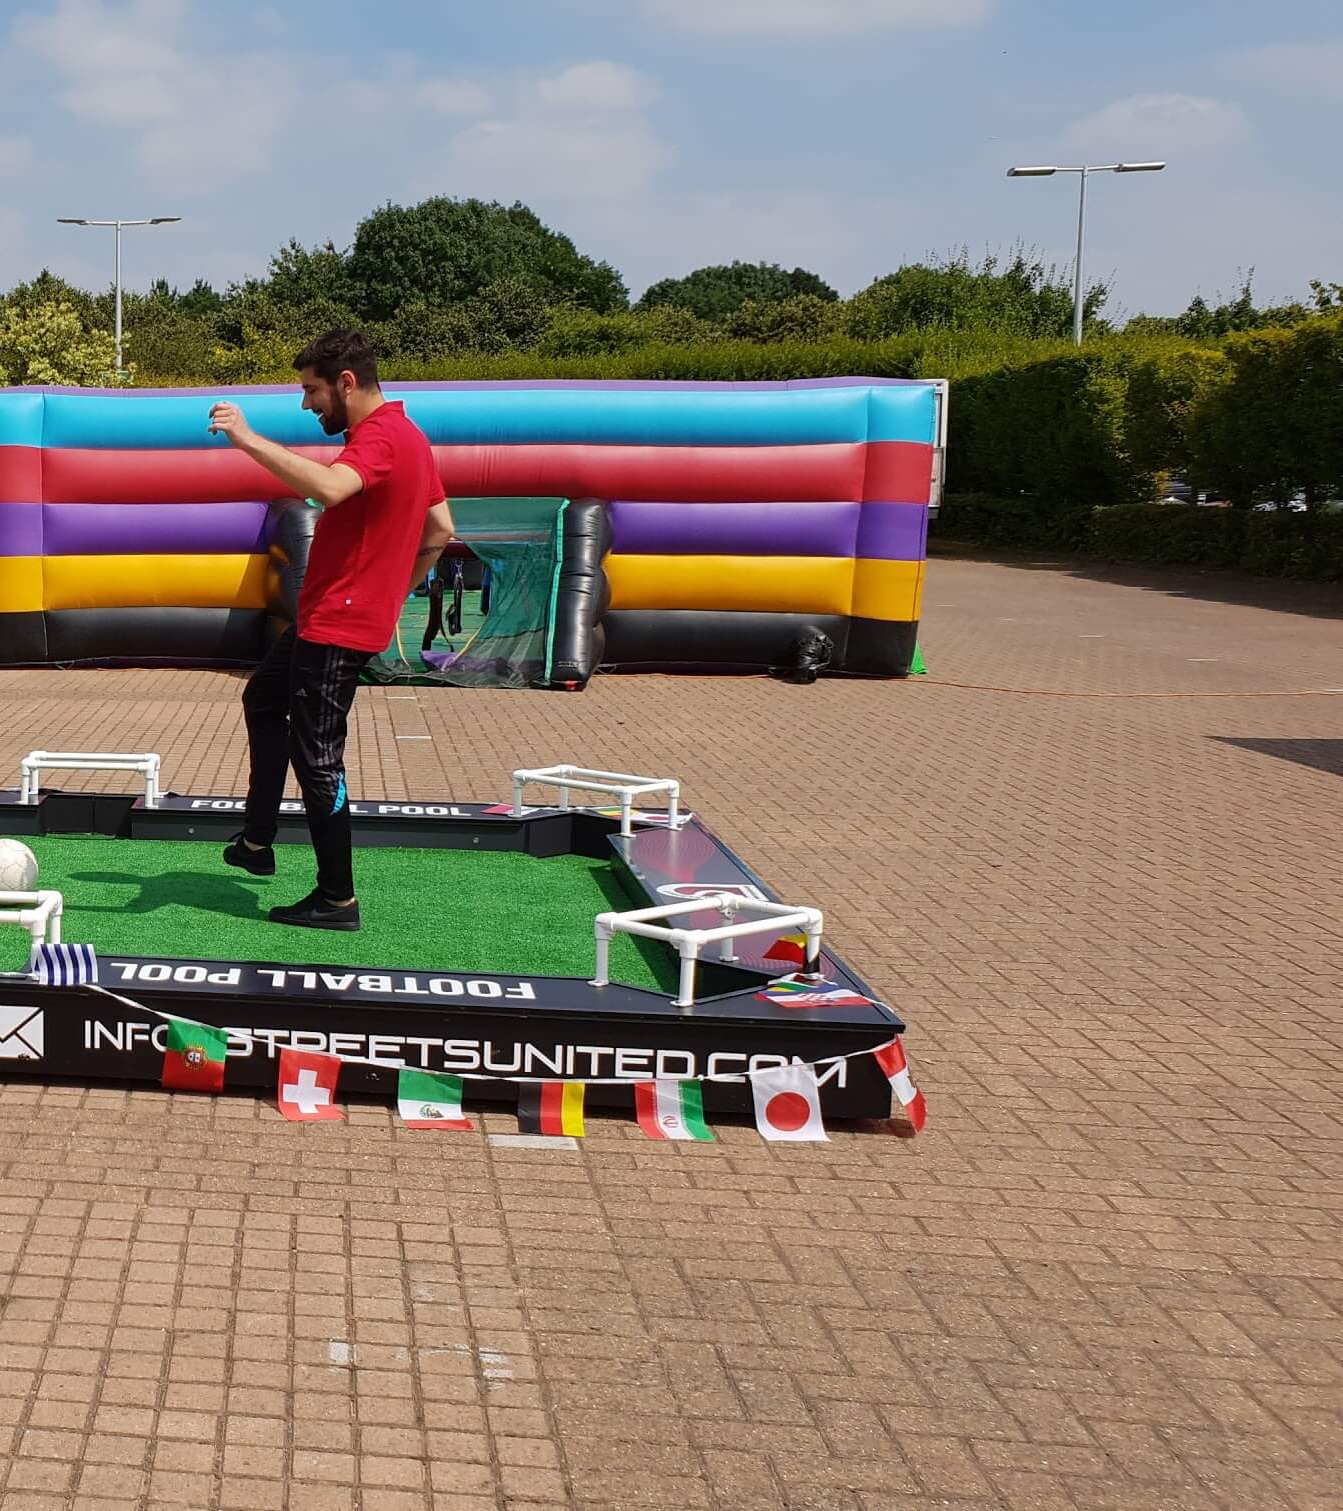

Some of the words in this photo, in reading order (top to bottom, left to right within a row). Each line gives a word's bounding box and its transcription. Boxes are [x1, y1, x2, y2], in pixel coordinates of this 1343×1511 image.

[378, 804, 472, 817] POOL
[110, 962, 241, 985] POOL
[257, 968, 537, 1000] FOOTBALL
